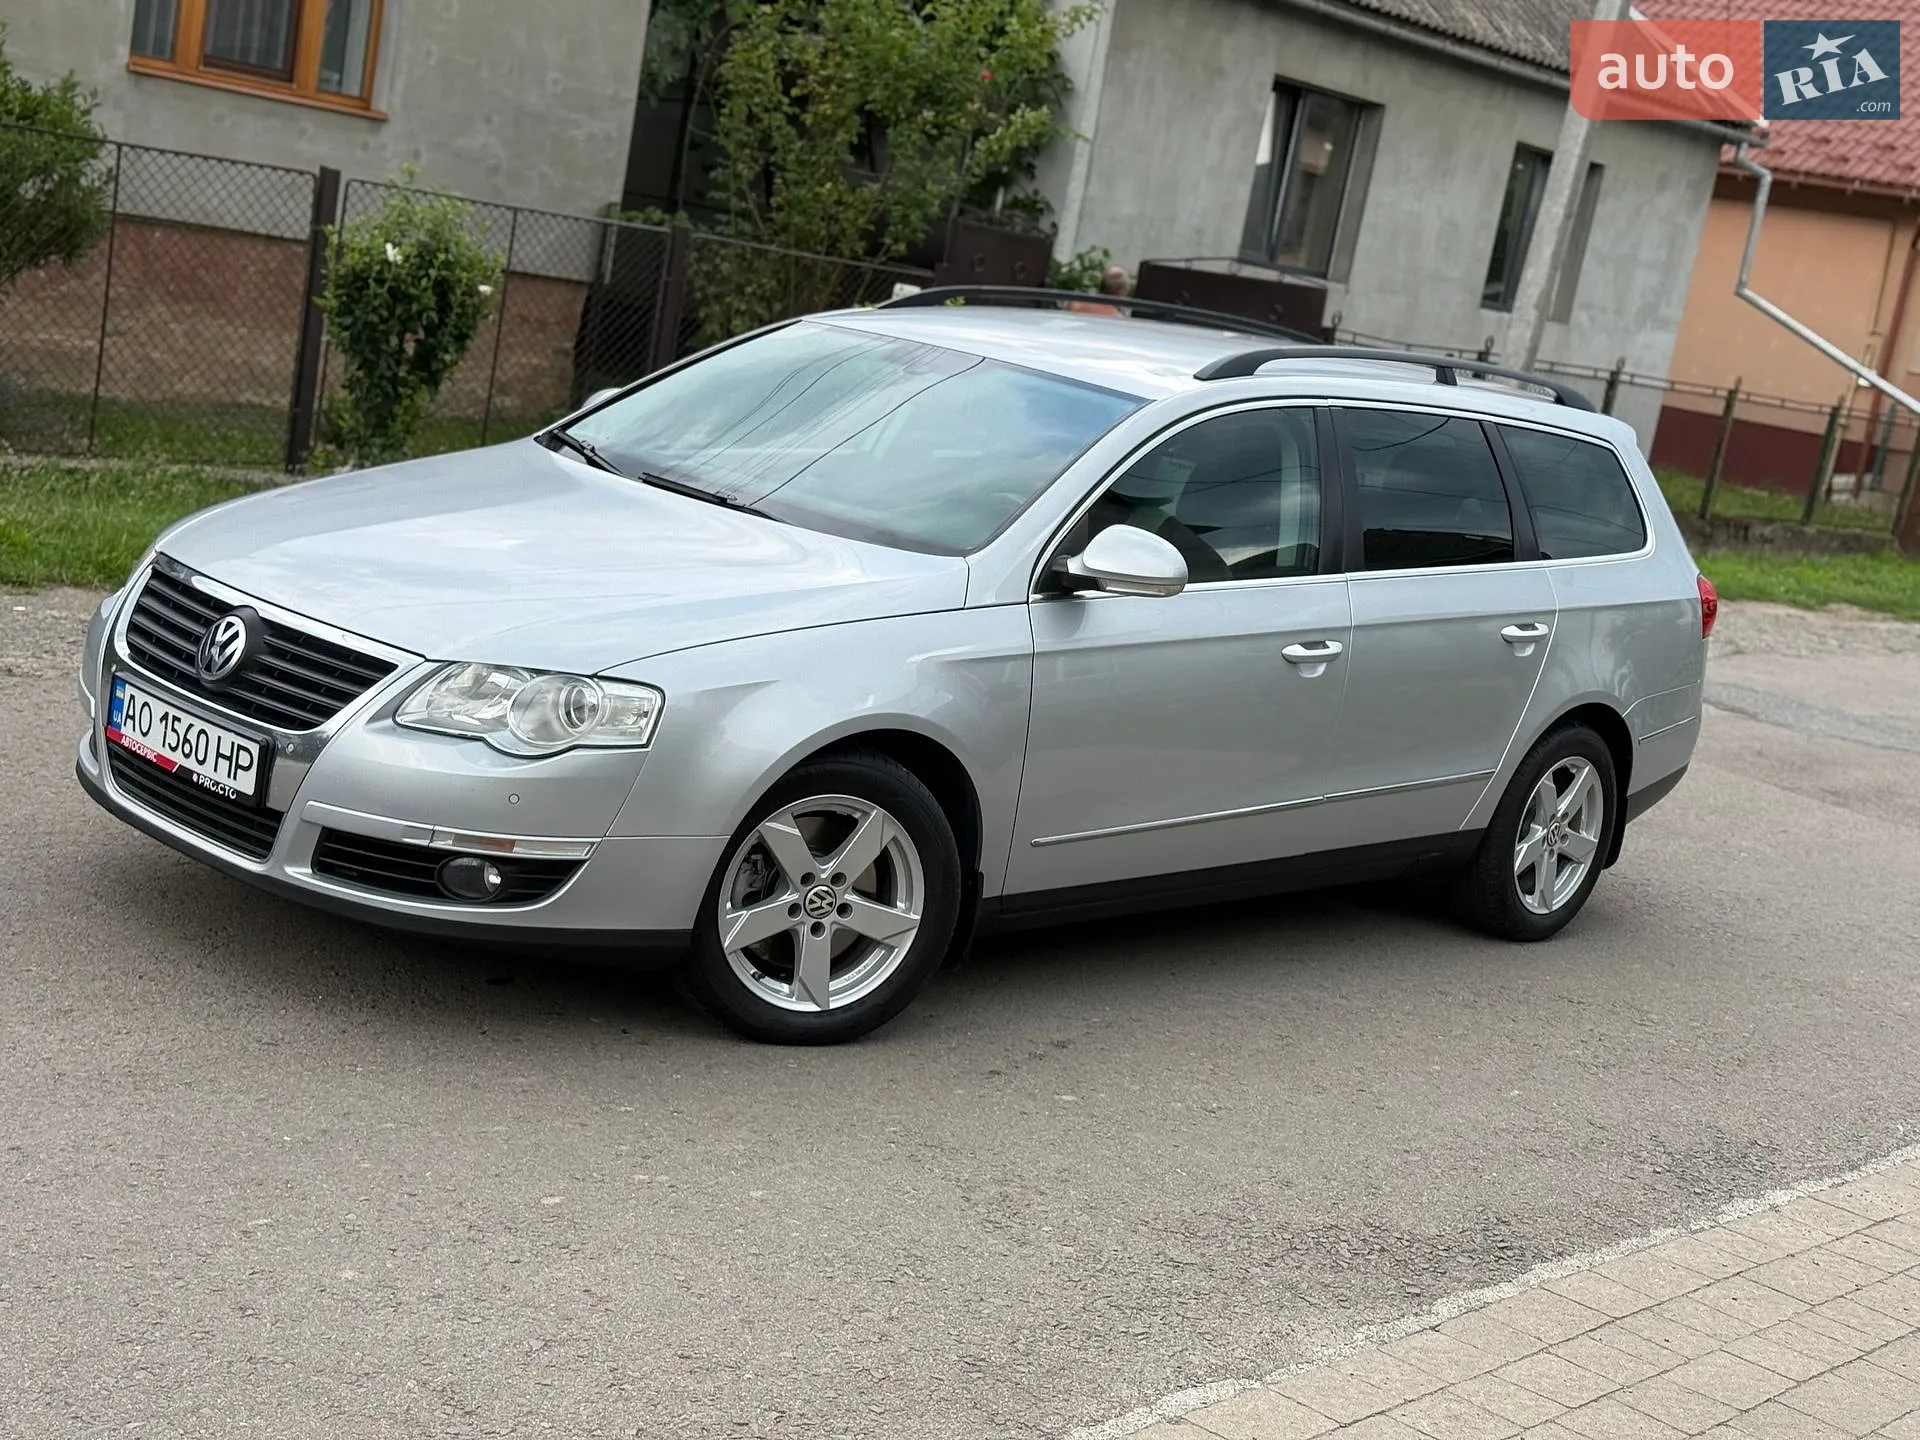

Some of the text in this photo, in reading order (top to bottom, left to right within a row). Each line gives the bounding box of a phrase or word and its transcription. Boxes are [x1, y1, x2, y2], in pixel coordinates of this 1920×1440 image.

[113, 710, 122, 725] UA
[123, 693, 254, 781] AO 1560 HP
